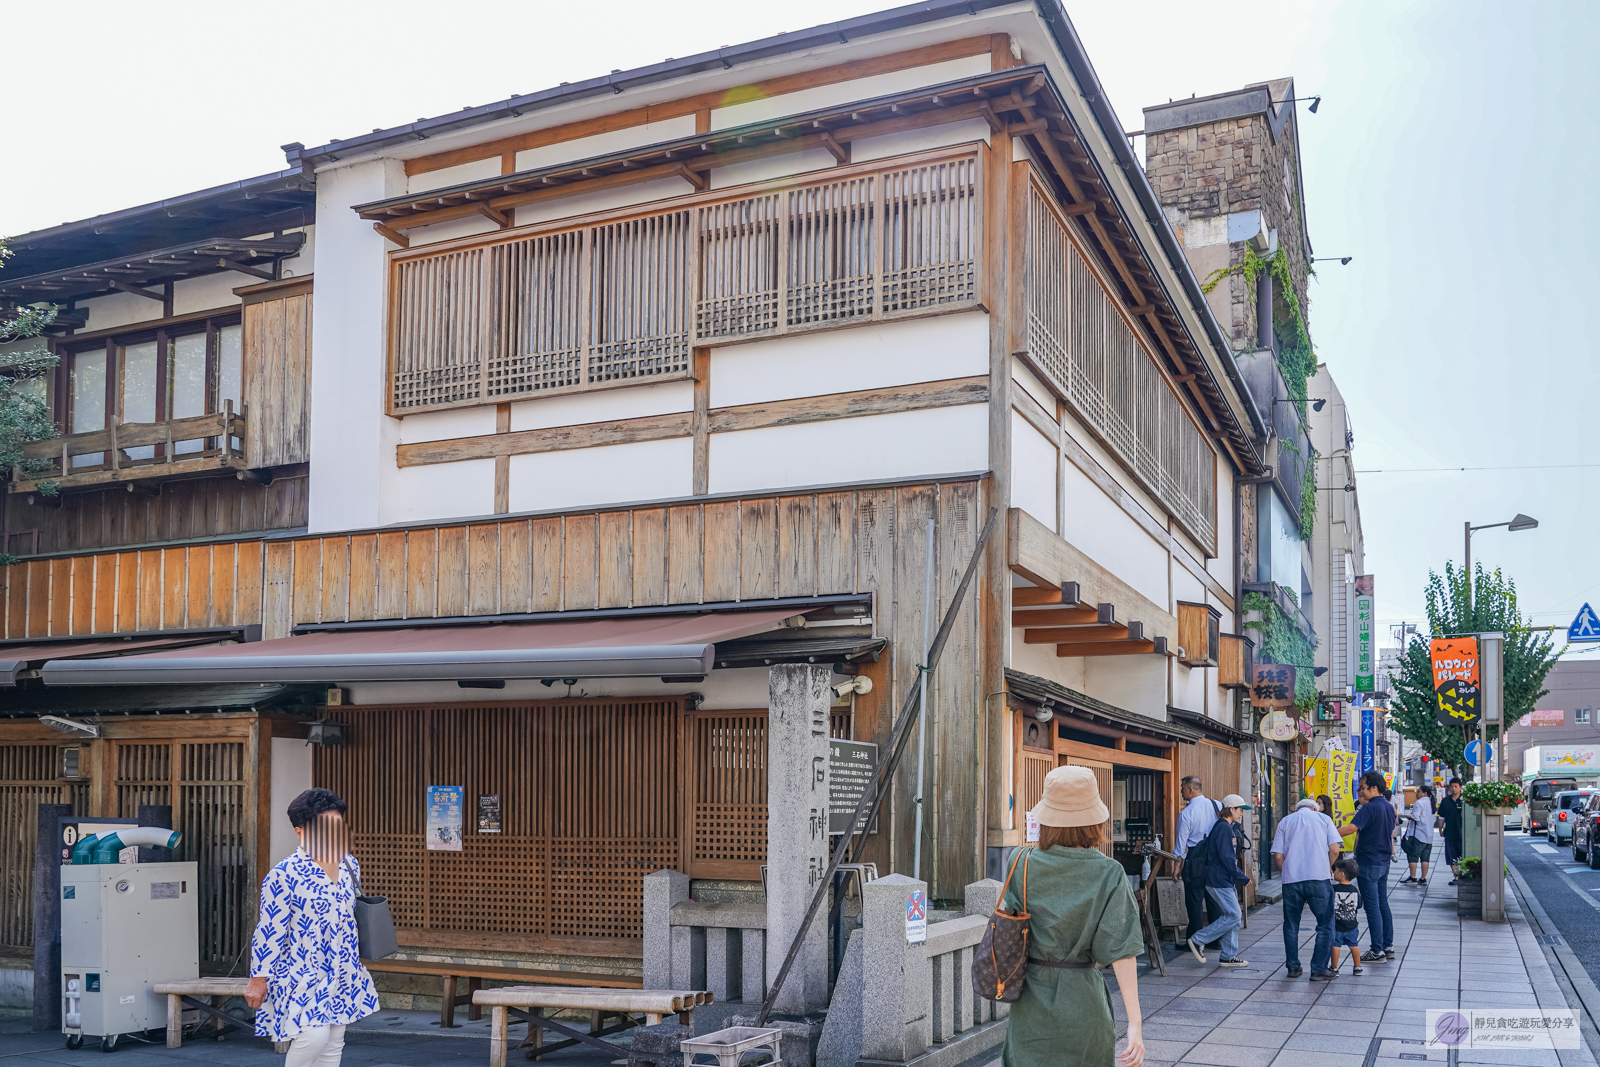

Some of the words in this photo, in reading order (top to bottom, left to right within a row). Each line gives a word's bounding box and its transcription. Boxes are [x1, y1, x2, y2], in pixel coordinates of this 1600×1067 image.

[1358, 612, 1370, 672] 杉山矯正歯科
[1435, 658, 1476, 670] ハロウィン
[1438, 669, 1472, 680] パレード
[1360, 678, 1370, 686] 3F
[810, 710, 828, 888] 三石神社
